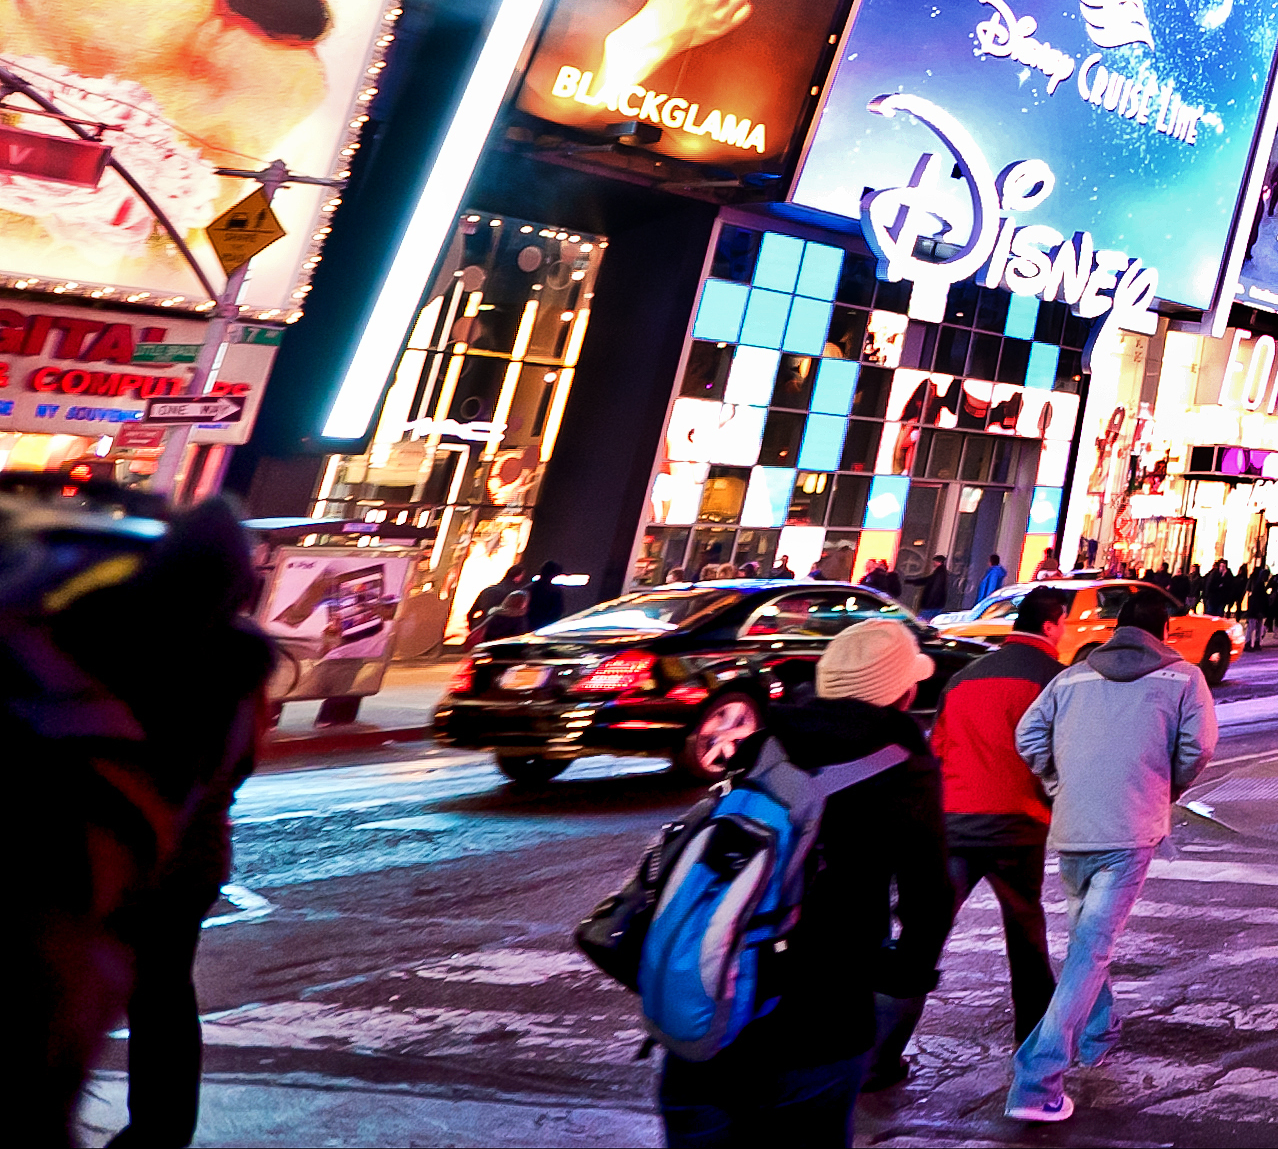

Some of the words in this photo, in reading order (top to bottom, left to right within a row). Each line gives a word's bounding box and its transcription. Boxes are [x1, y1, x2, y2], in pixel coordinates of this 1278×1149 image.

[1077, 52, 1153, 125] CRUISE
[1155, 83, 1201, 147] LINE
[858, 91, 1160, 376] DISNEY
[31, 366, 251, 399] COMPUTRS
